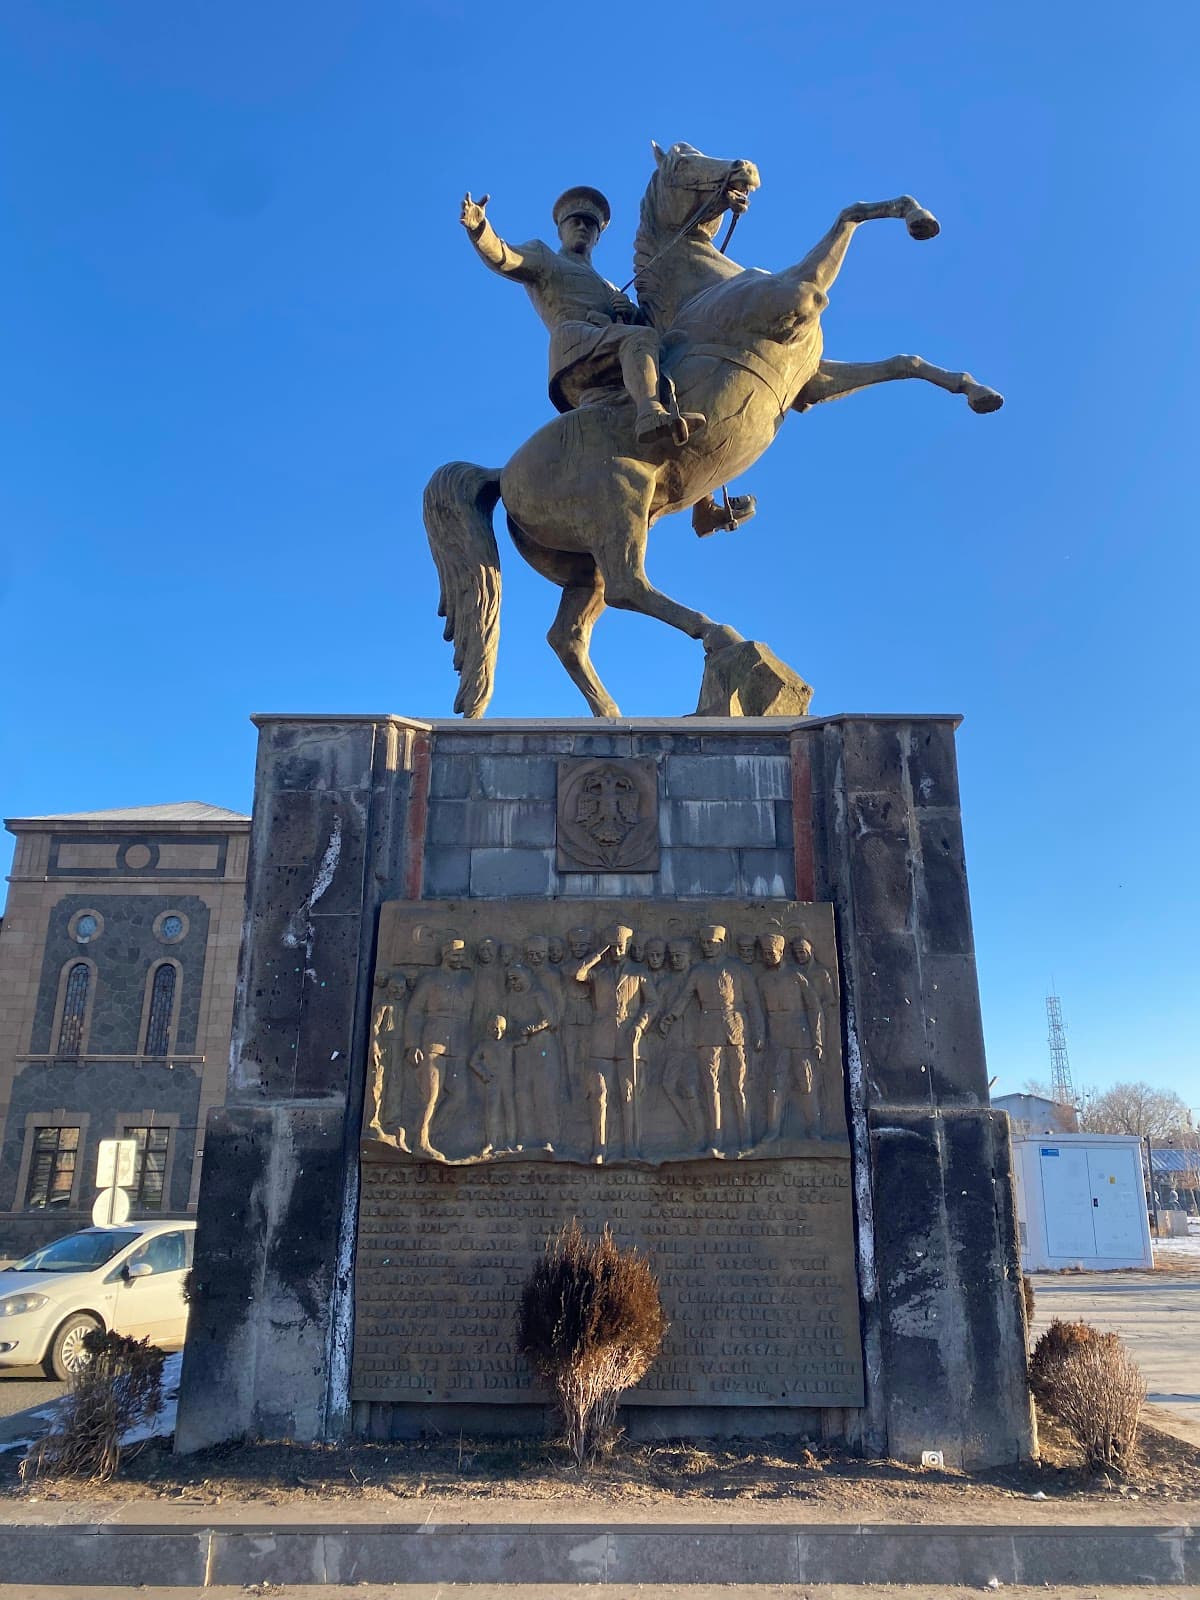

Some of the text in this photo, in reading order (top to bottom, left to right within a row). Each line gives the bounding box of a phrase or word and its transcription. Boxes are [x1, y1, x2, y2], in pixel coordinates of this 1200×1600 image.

[364, 1165, 456, 1184] ATATÜRK
[559, 1190, 579, 1201] VE
[591, 1189, 683, 1203] JEOPOLİTİK
